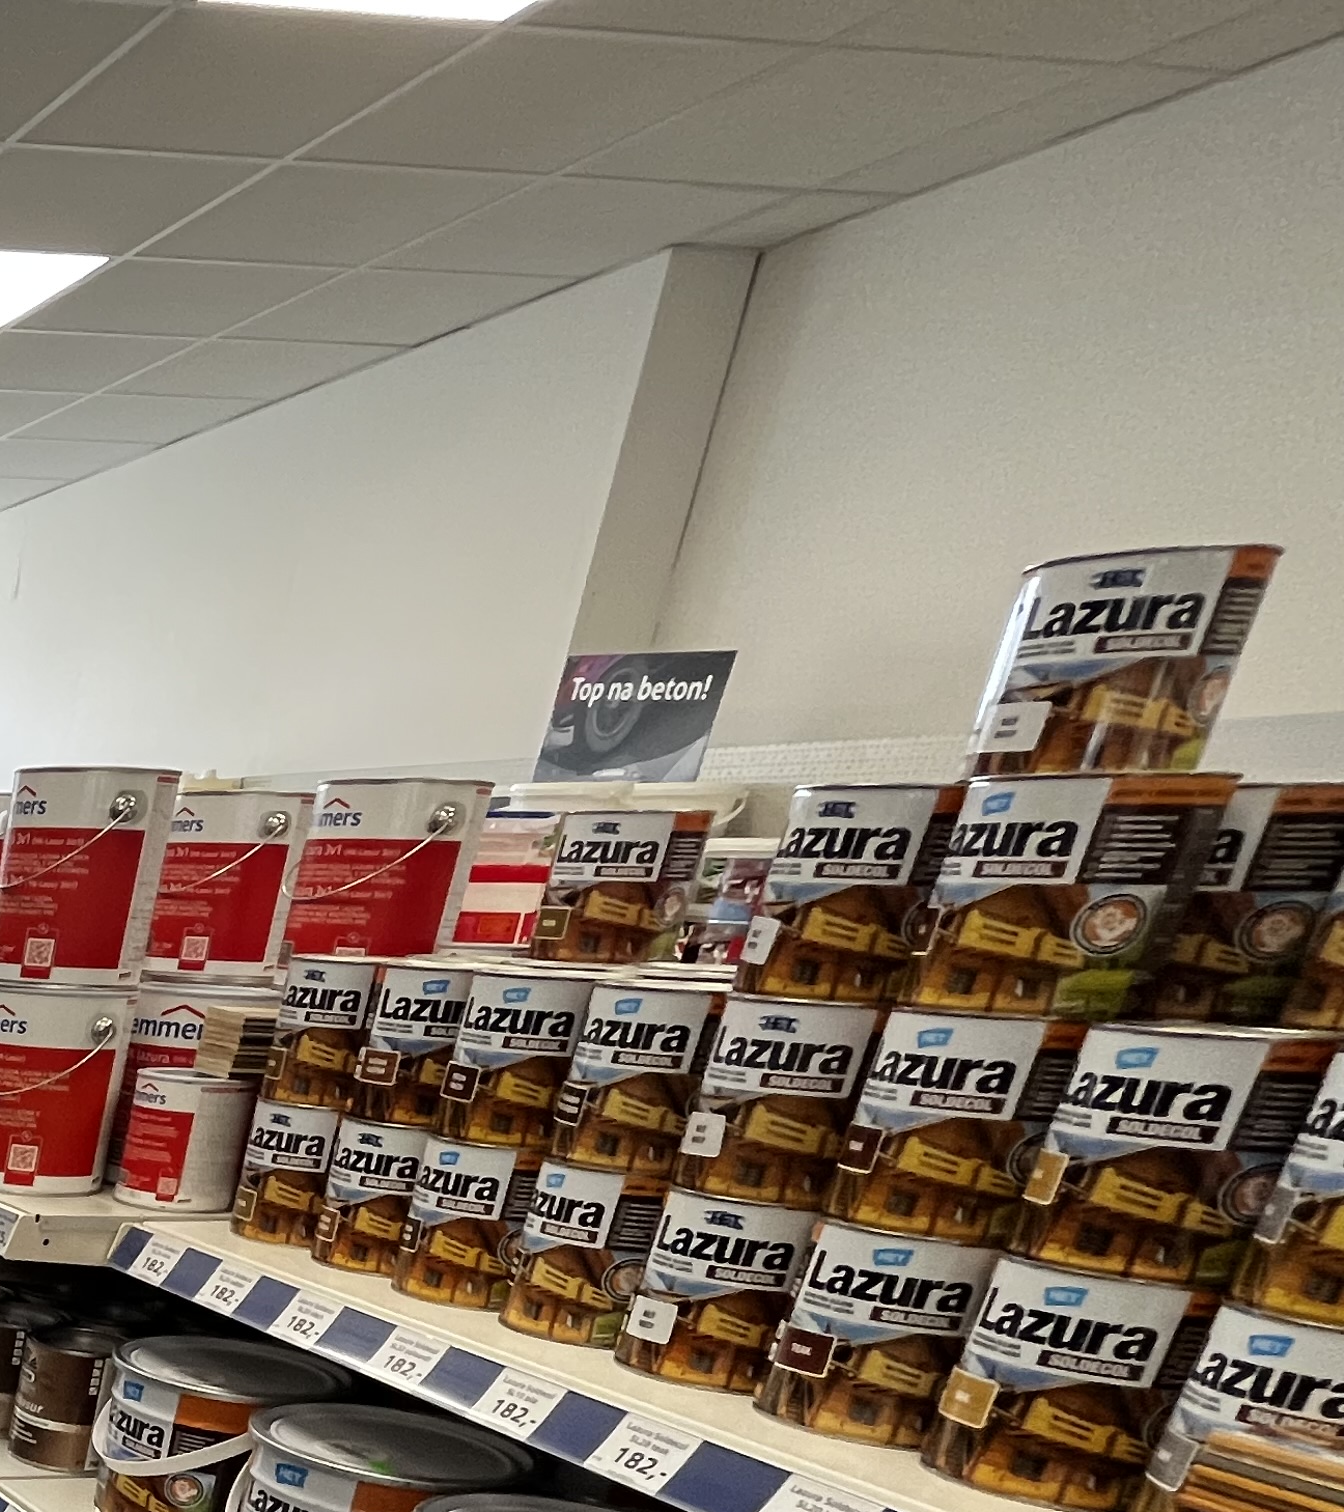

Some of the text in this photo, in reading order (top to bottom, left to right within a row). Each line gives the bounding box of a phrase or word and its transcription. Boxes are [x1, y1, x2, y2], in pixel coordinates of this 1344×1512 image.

[1022, 588, 1205, 639] Lazura
[570, 673, 712, 703] Top na beton!
[713, 1023, 853, 1076] Lazura
[657, 1213, 795, 1271] Lazura
[210, 1284, 239, 1305] 182,-
[809, 1248, 973, 1314] Lazura
[286, 1315, 320, 1338] 182,-
[878, 1309, 953, 1328] SOLDECOL
[980, 1285, 1159, 1362] Lazura
[383, 1354, 422, 1380] 182,-
[1048, 1351, 1132, 1379] SOLDECOL
[491, 1399, 537, 1428] 182,-
[614, 1447, 667, 1479] 182,-
